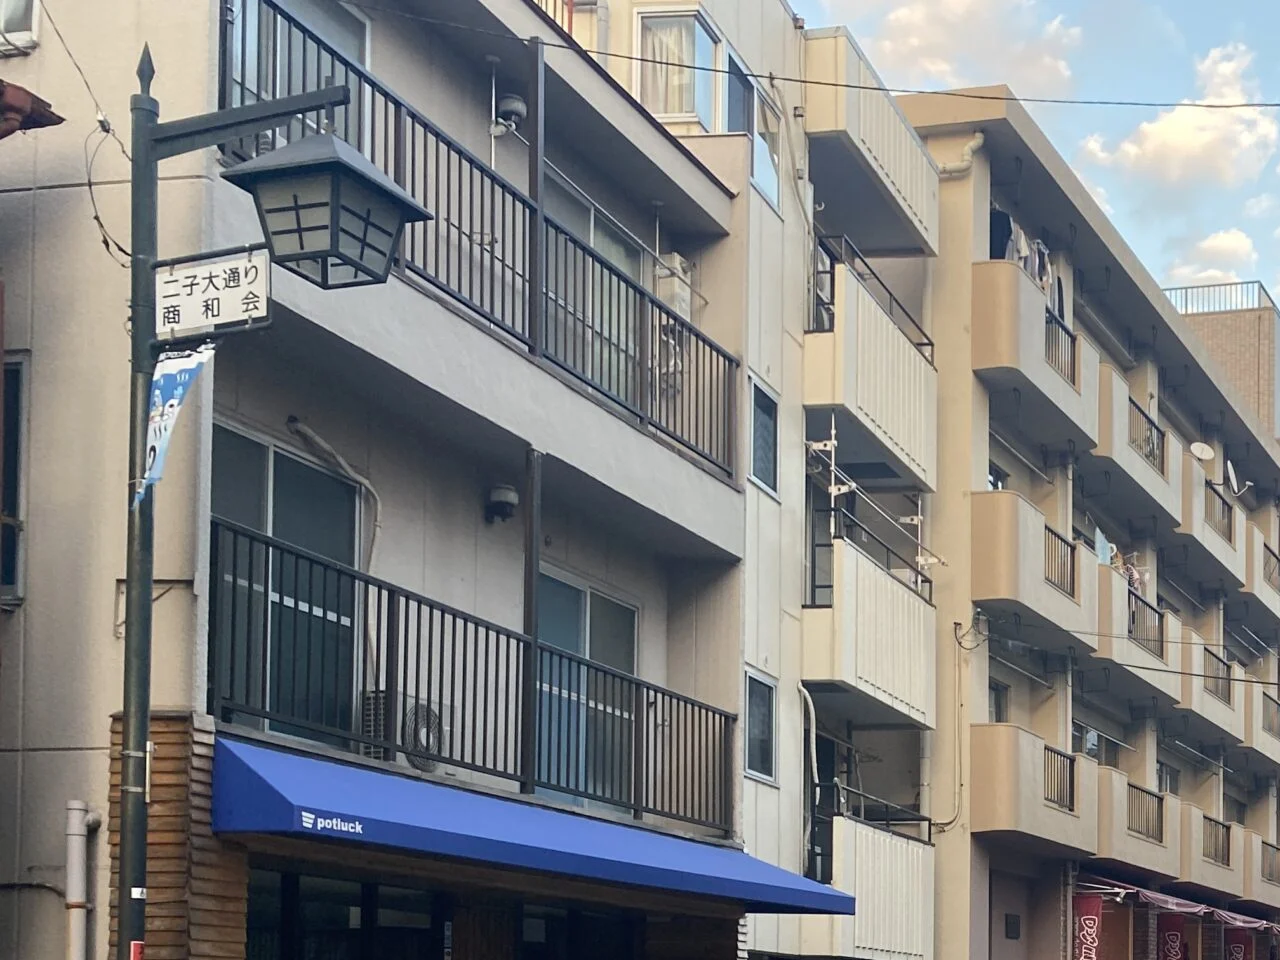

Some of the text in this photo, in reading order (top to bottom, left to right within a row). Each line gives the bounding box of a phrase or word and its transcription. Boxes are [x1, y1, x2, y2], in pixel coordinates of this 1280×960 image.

[162, 264, 260, 300] 二子大通り
[162, 290, 260, 327] 商和会
[317, 818, 363, 834] potluck
